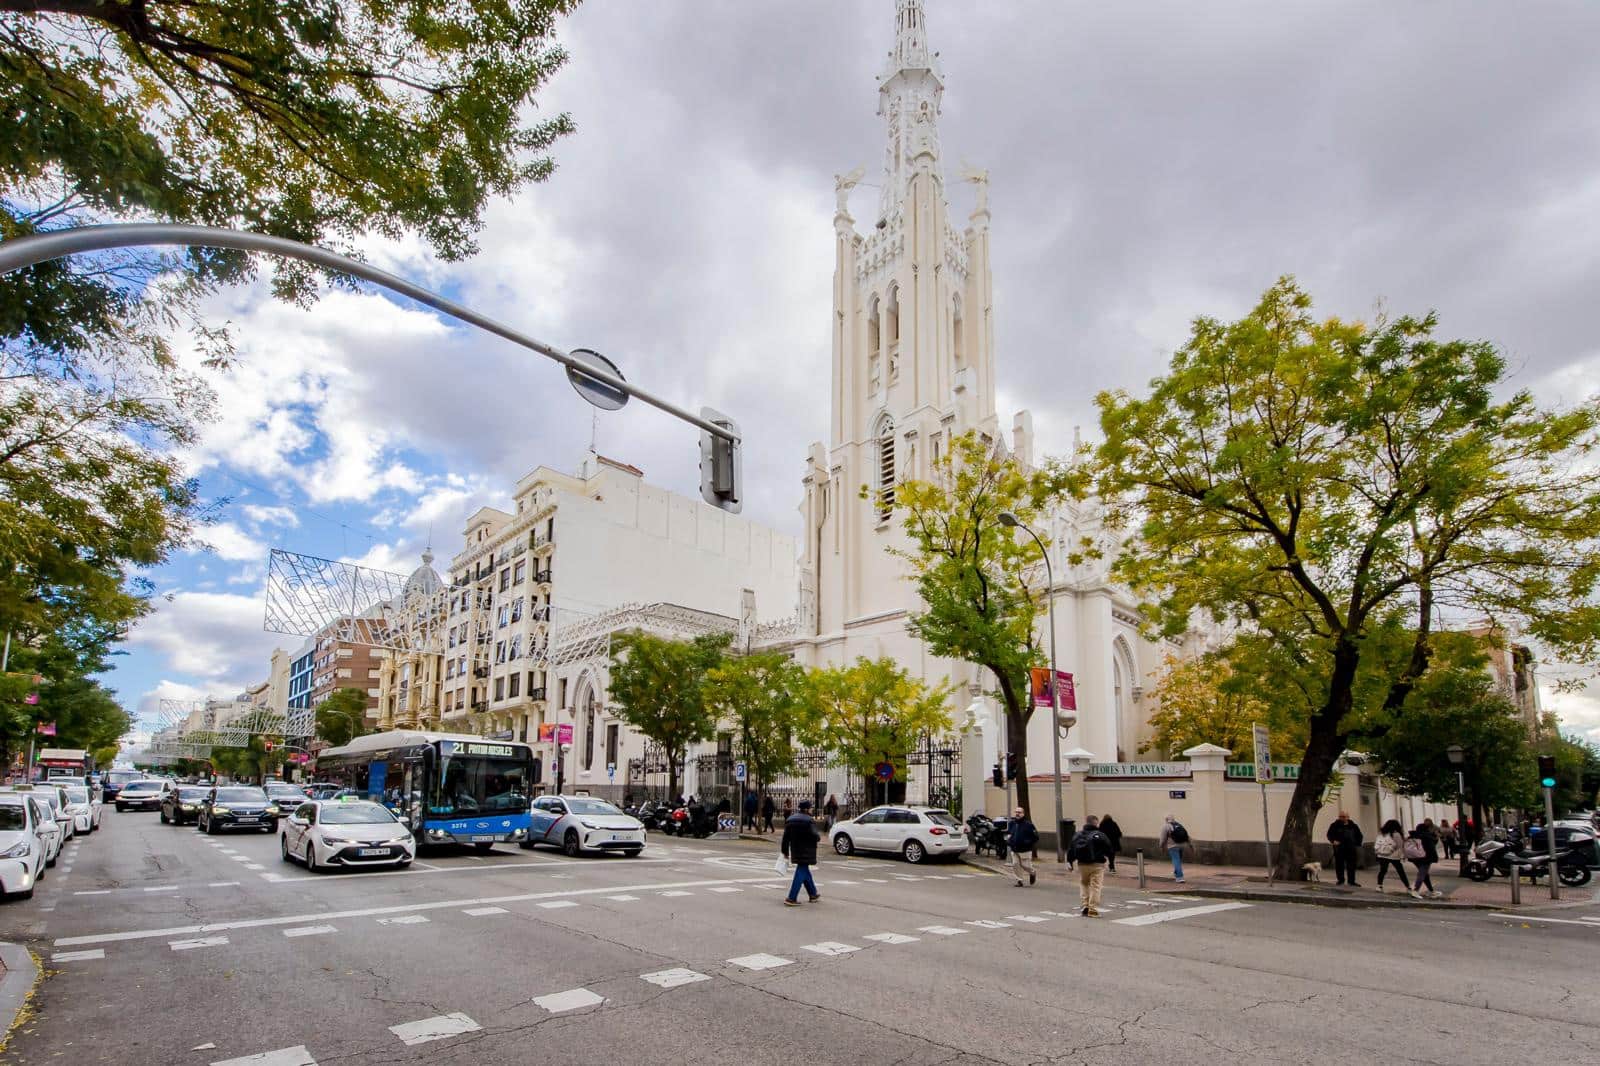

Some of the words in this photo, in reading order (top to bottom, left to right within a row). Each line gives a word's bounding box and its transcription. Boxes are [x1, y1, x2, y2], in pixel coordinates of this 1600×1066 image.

[452, 742, 464, 754] 21
[1091, 765, 1119, 775] FLORES
[1121, 765, 1127, 774] Y
[1130, 764, 1166, 774] PLANTAS
[1229, 764, 1254, 777] FLOR
[1272, 766, 1278, 777] Y
